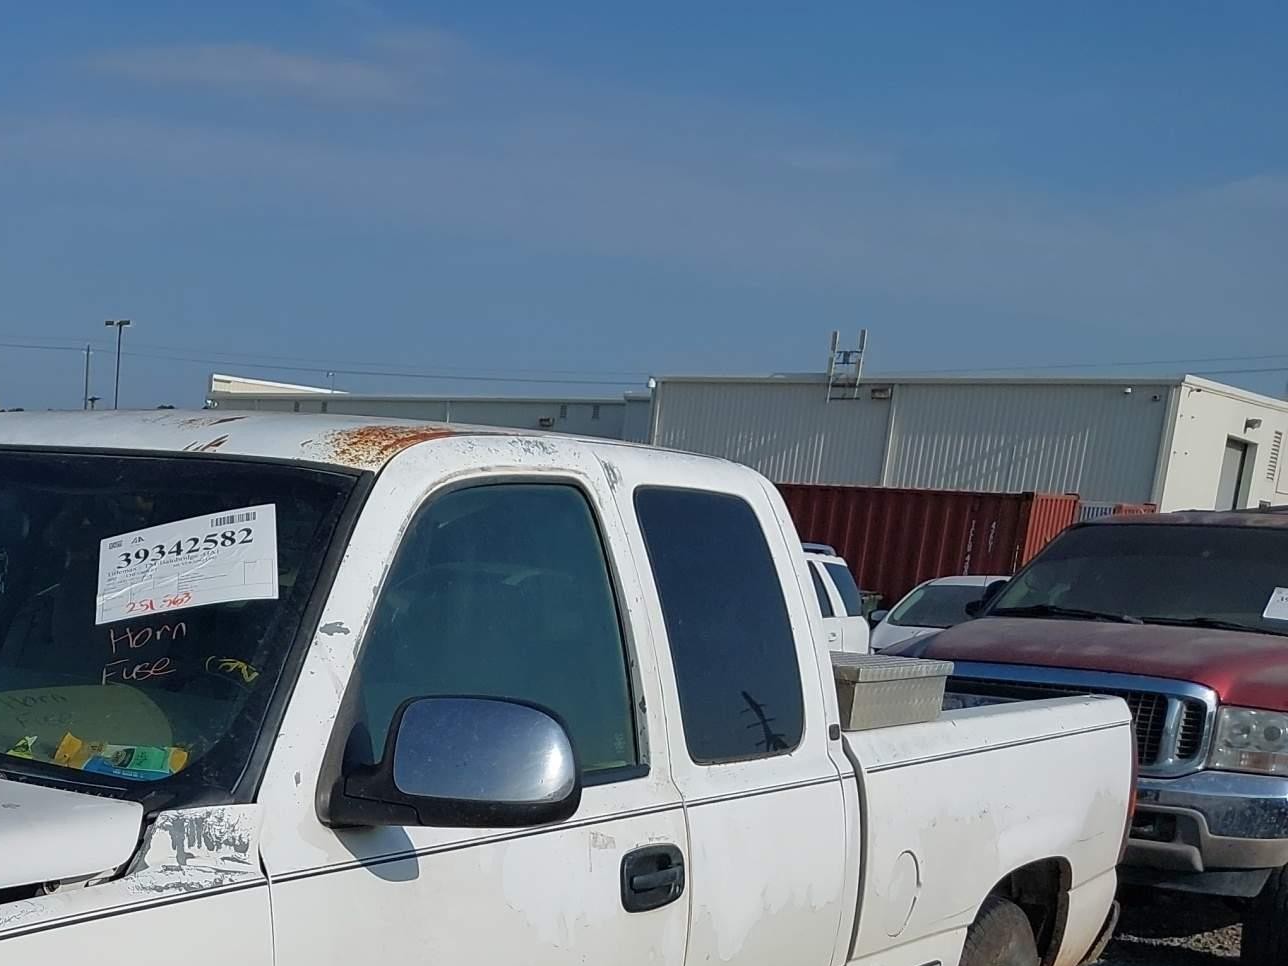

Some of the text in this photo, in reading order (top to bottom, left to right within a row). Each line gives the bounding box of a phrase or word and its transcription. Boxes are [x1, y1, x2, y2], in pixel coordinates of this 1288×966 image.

[116, 527, 254, 570] 39342582
[110, 622, 186, 654] Horn
[101, 656, 177, 686] Fuse
